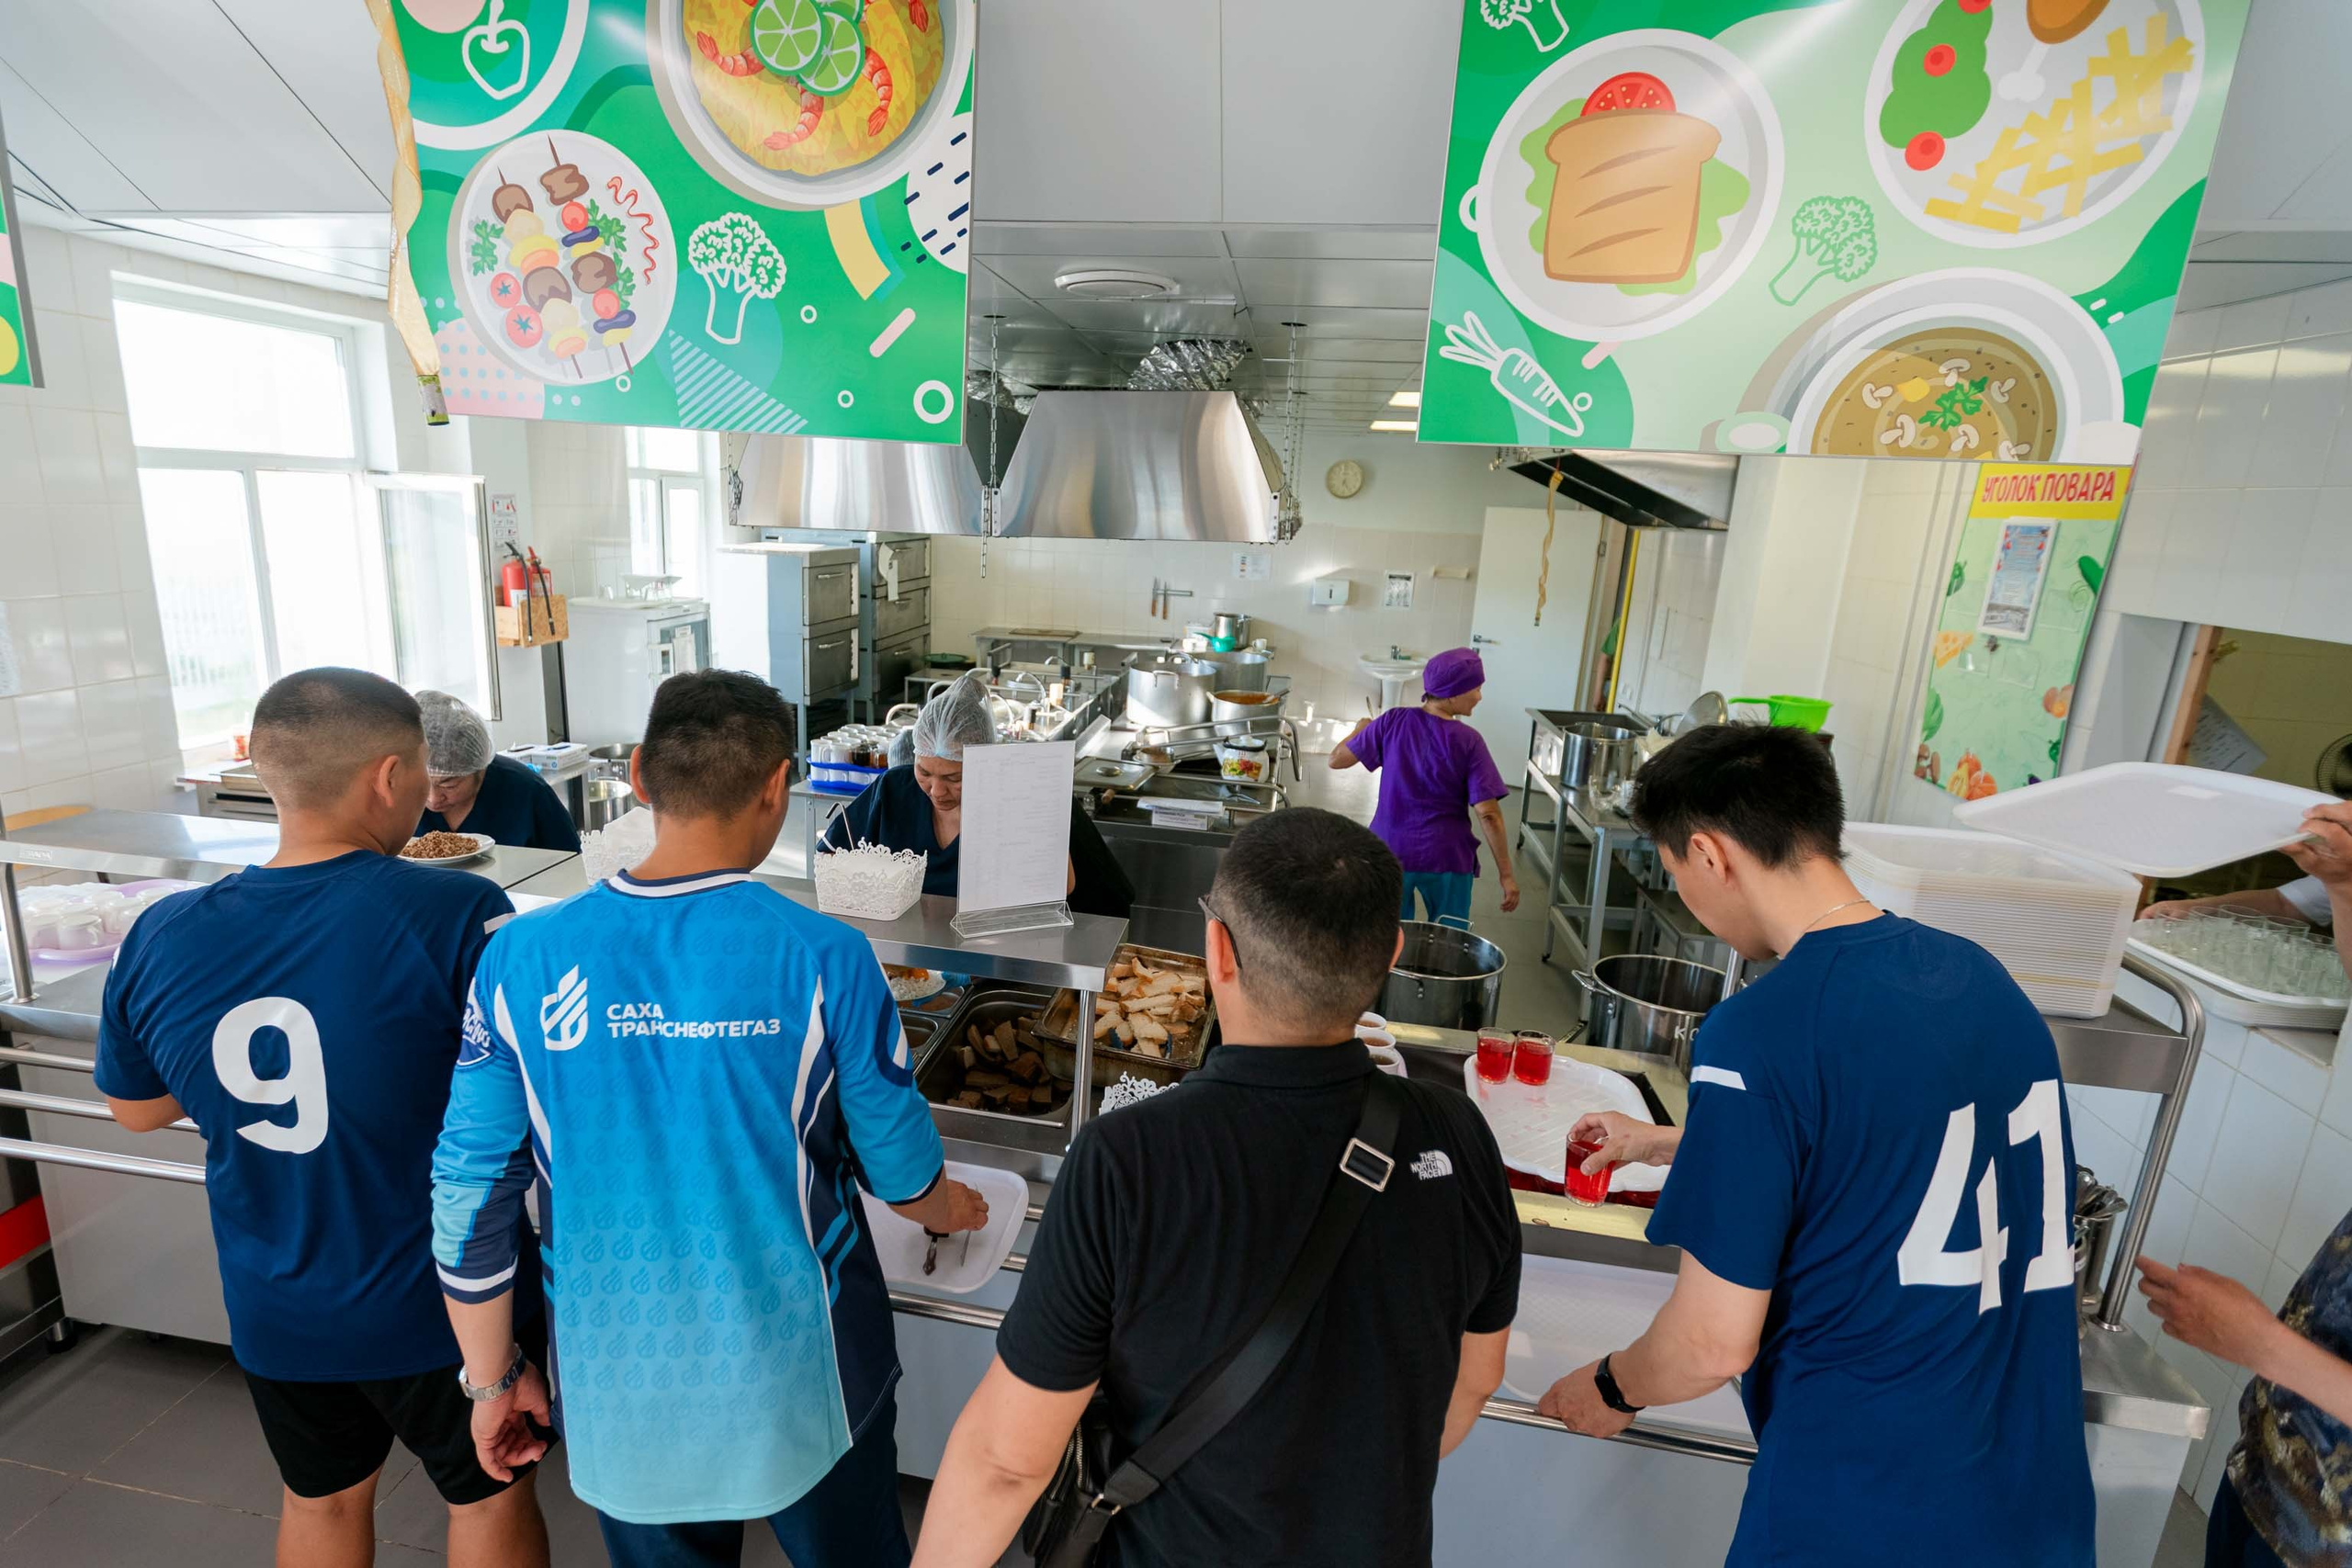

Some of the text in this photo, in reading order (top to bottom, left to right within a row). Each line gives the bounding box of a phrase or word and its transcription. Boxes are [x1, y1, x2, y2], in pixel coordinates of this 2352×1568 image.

[1981, 470, 2116, 502] УГОЛОК ПОВАРА
[606, 1002, 664, 1021] САХА
[606, 1019, 781, 1039] ТРАНСНЕФТЕГАЗ
[212, 996, 329, 1155] 9
[1409, 1159, 1438, 1174] NORTH
[1419, 1151, 1436, 1163] THE
[1419, 1168, 1439, 1180] FACE
[1897, 1078, 2075, 1316] 41
